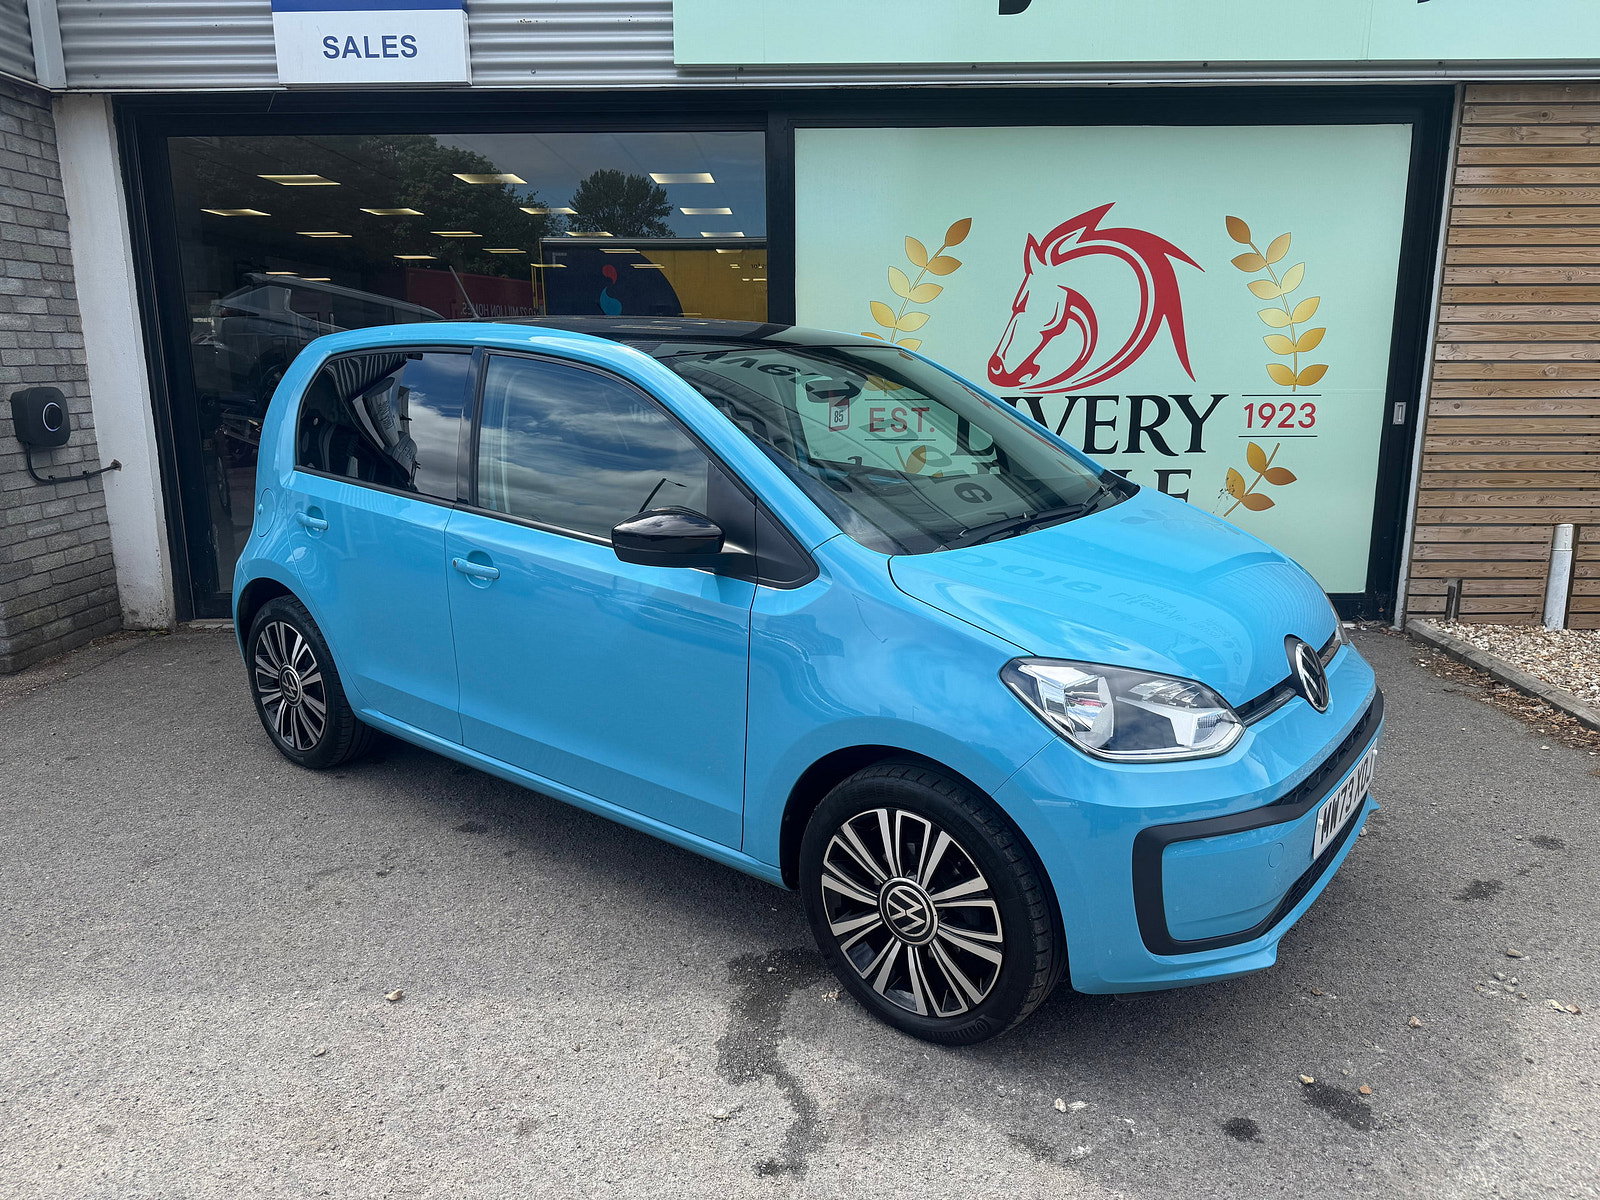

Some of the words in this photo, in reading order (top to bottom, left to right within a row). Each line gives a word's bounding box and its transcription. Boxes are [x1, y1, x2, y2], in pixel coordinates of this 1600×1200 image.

[322, 34, 418, 59] SALES
[833, 410, 844, 423] 85
[869, 407, 935, 433] EST.
[950, 394, 1229, 457] LVERY
[1243, 402, 1316, 429] 1923
